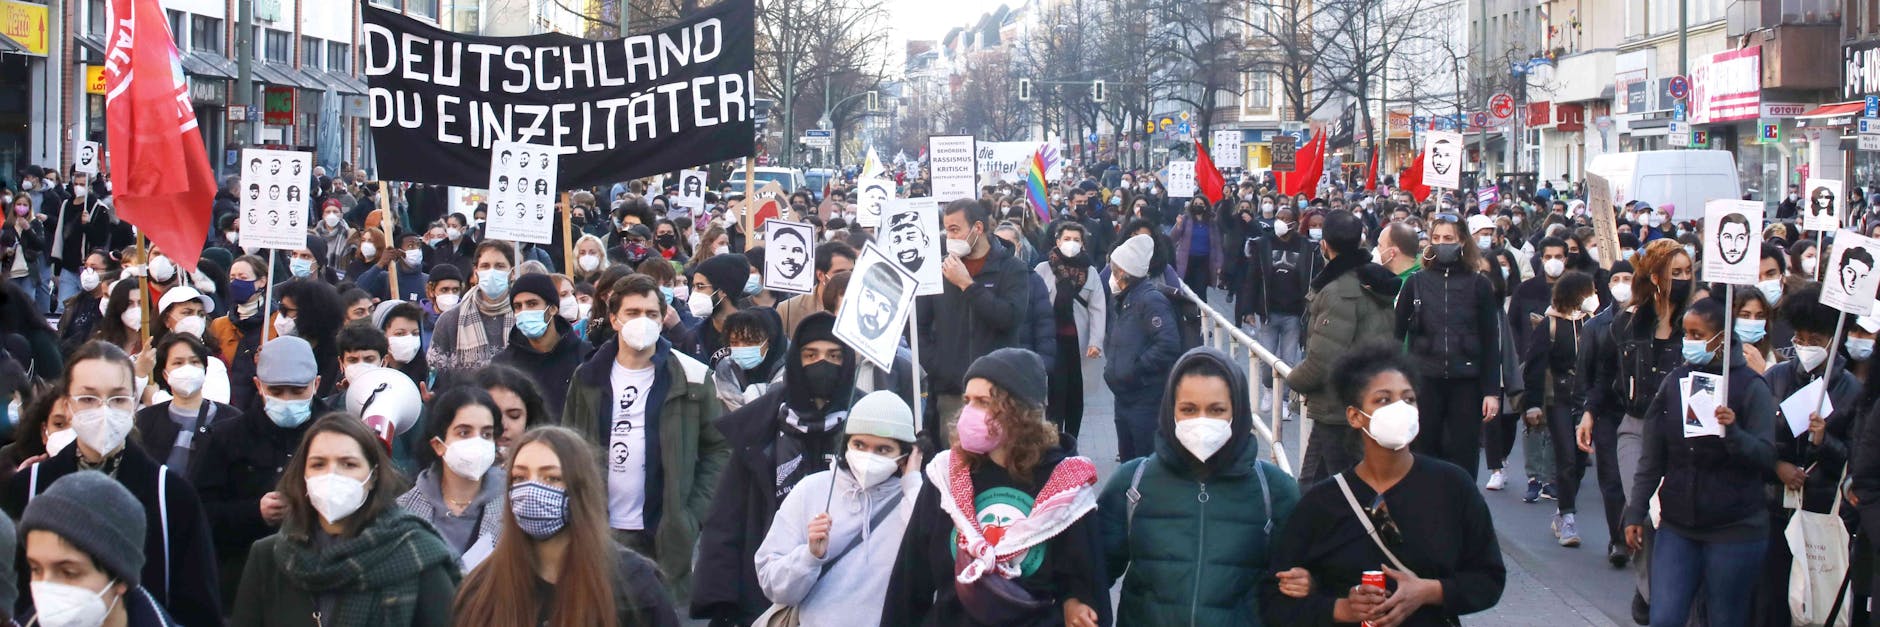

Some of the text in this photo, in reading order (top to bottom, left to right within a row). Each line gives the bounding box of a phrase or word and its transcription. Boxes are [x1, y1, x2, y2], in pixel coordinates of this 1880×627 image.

[5, 5, 30, 36] Netto
[363, 17, 723, 93] DEUTSCHLAND
[368, 70, 756, 154] DU EINZELTÄTER!
[1867, 97, 1874, 106] P
[978, 147, 994, 159] die
[1272, 143, 1296, 153] FCK
